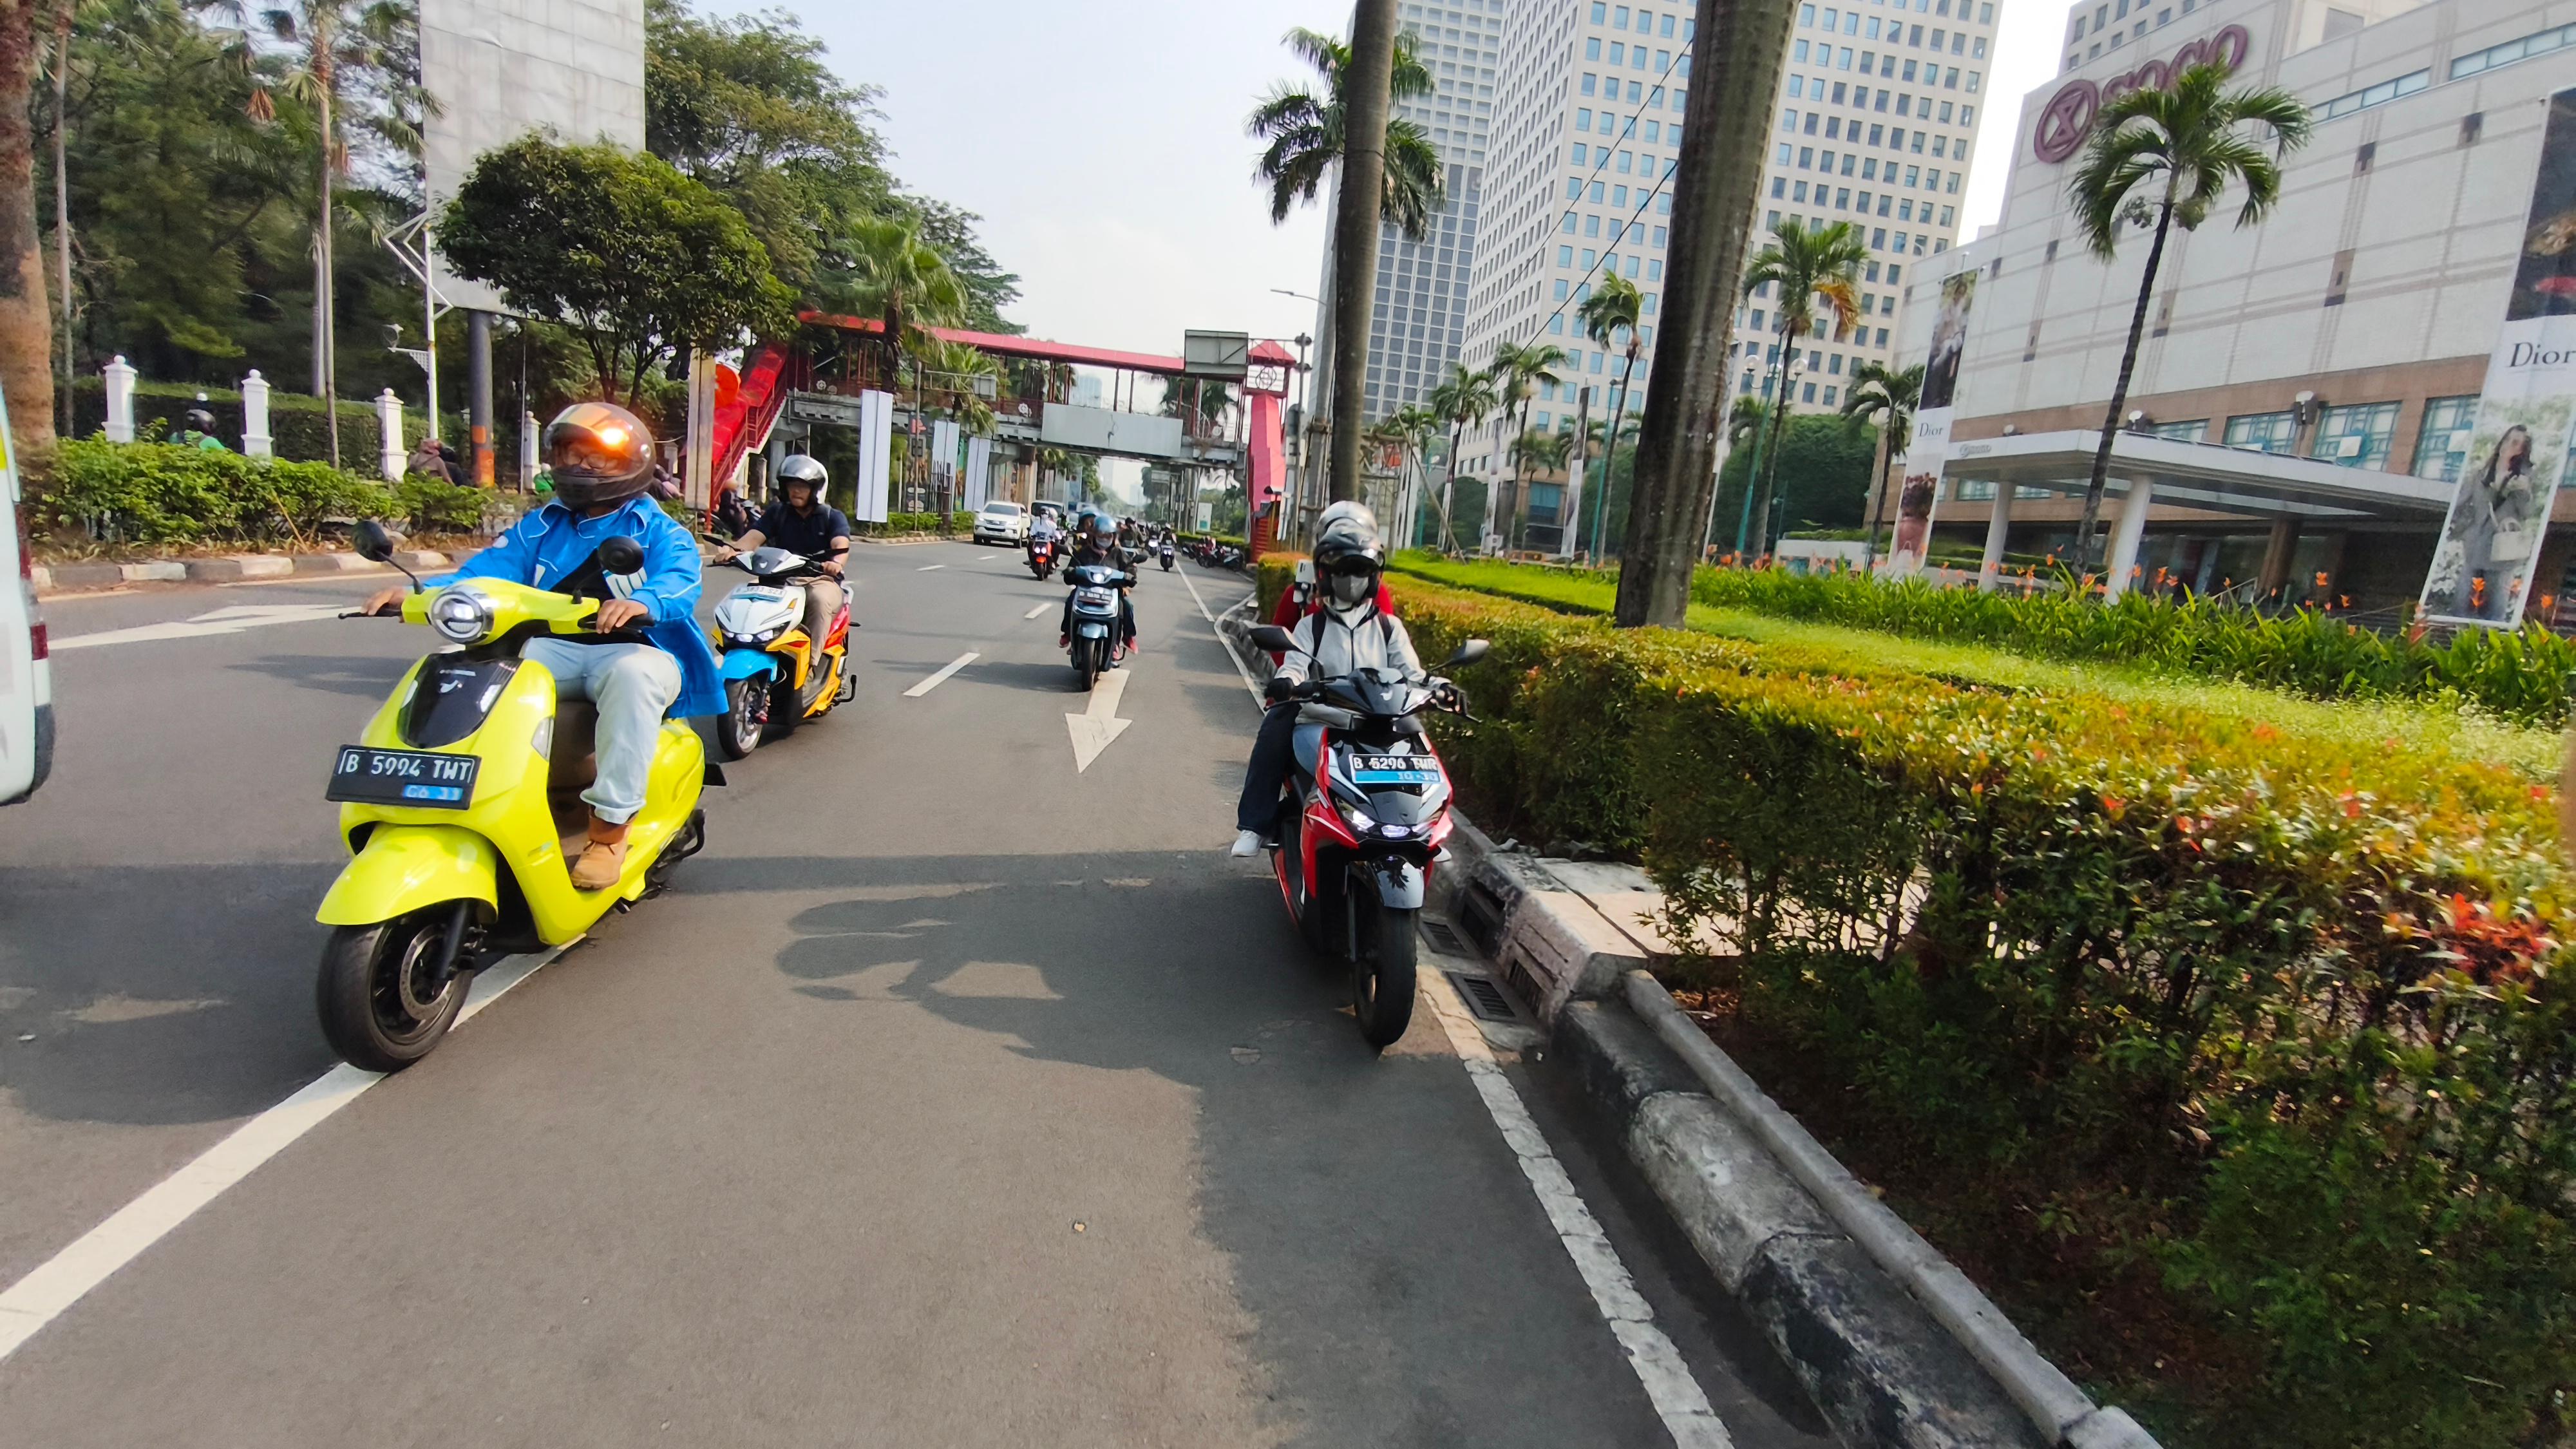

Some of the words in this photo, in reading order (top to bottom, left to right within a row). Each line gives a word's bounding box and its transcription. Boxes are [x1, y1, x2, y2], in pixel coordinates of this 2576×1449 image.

[2506, 342, 2576, 368] Dior
[1919, 422, 1944, 437] Dior
[346, 754, 359, 773] B
[371, 755, 421, 777] 5994
[433, 760, 472, 781] TWT
[1353, 757, 1364, 769] B
